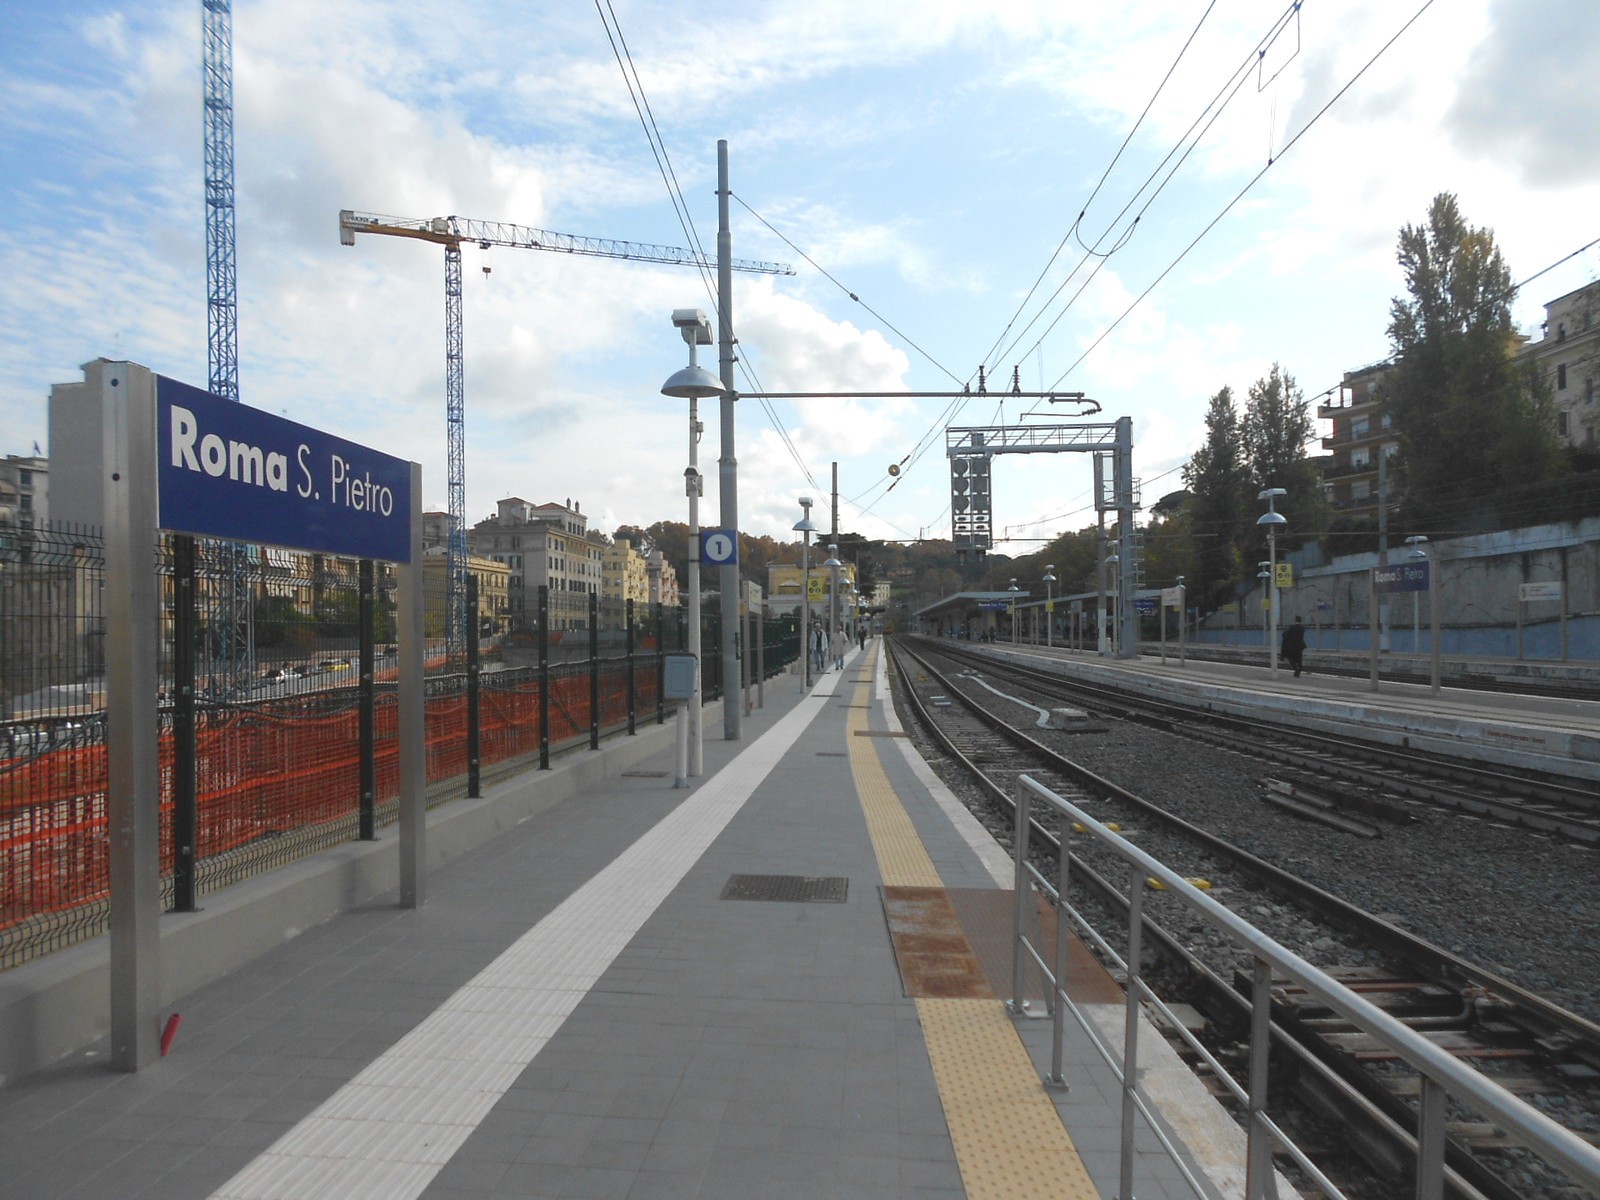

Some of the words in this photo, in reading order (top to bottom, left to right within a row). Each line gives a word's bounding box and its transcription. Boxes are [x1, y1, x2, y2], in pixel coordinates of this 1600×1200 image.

[171, 404, 288, 492] Roma
[297, 443, 320, 500] S.
[332, 454, 393, 516] Pietro
[715, 541, 722, 555] 1
[1374, 570, 1396, 582] Roma
